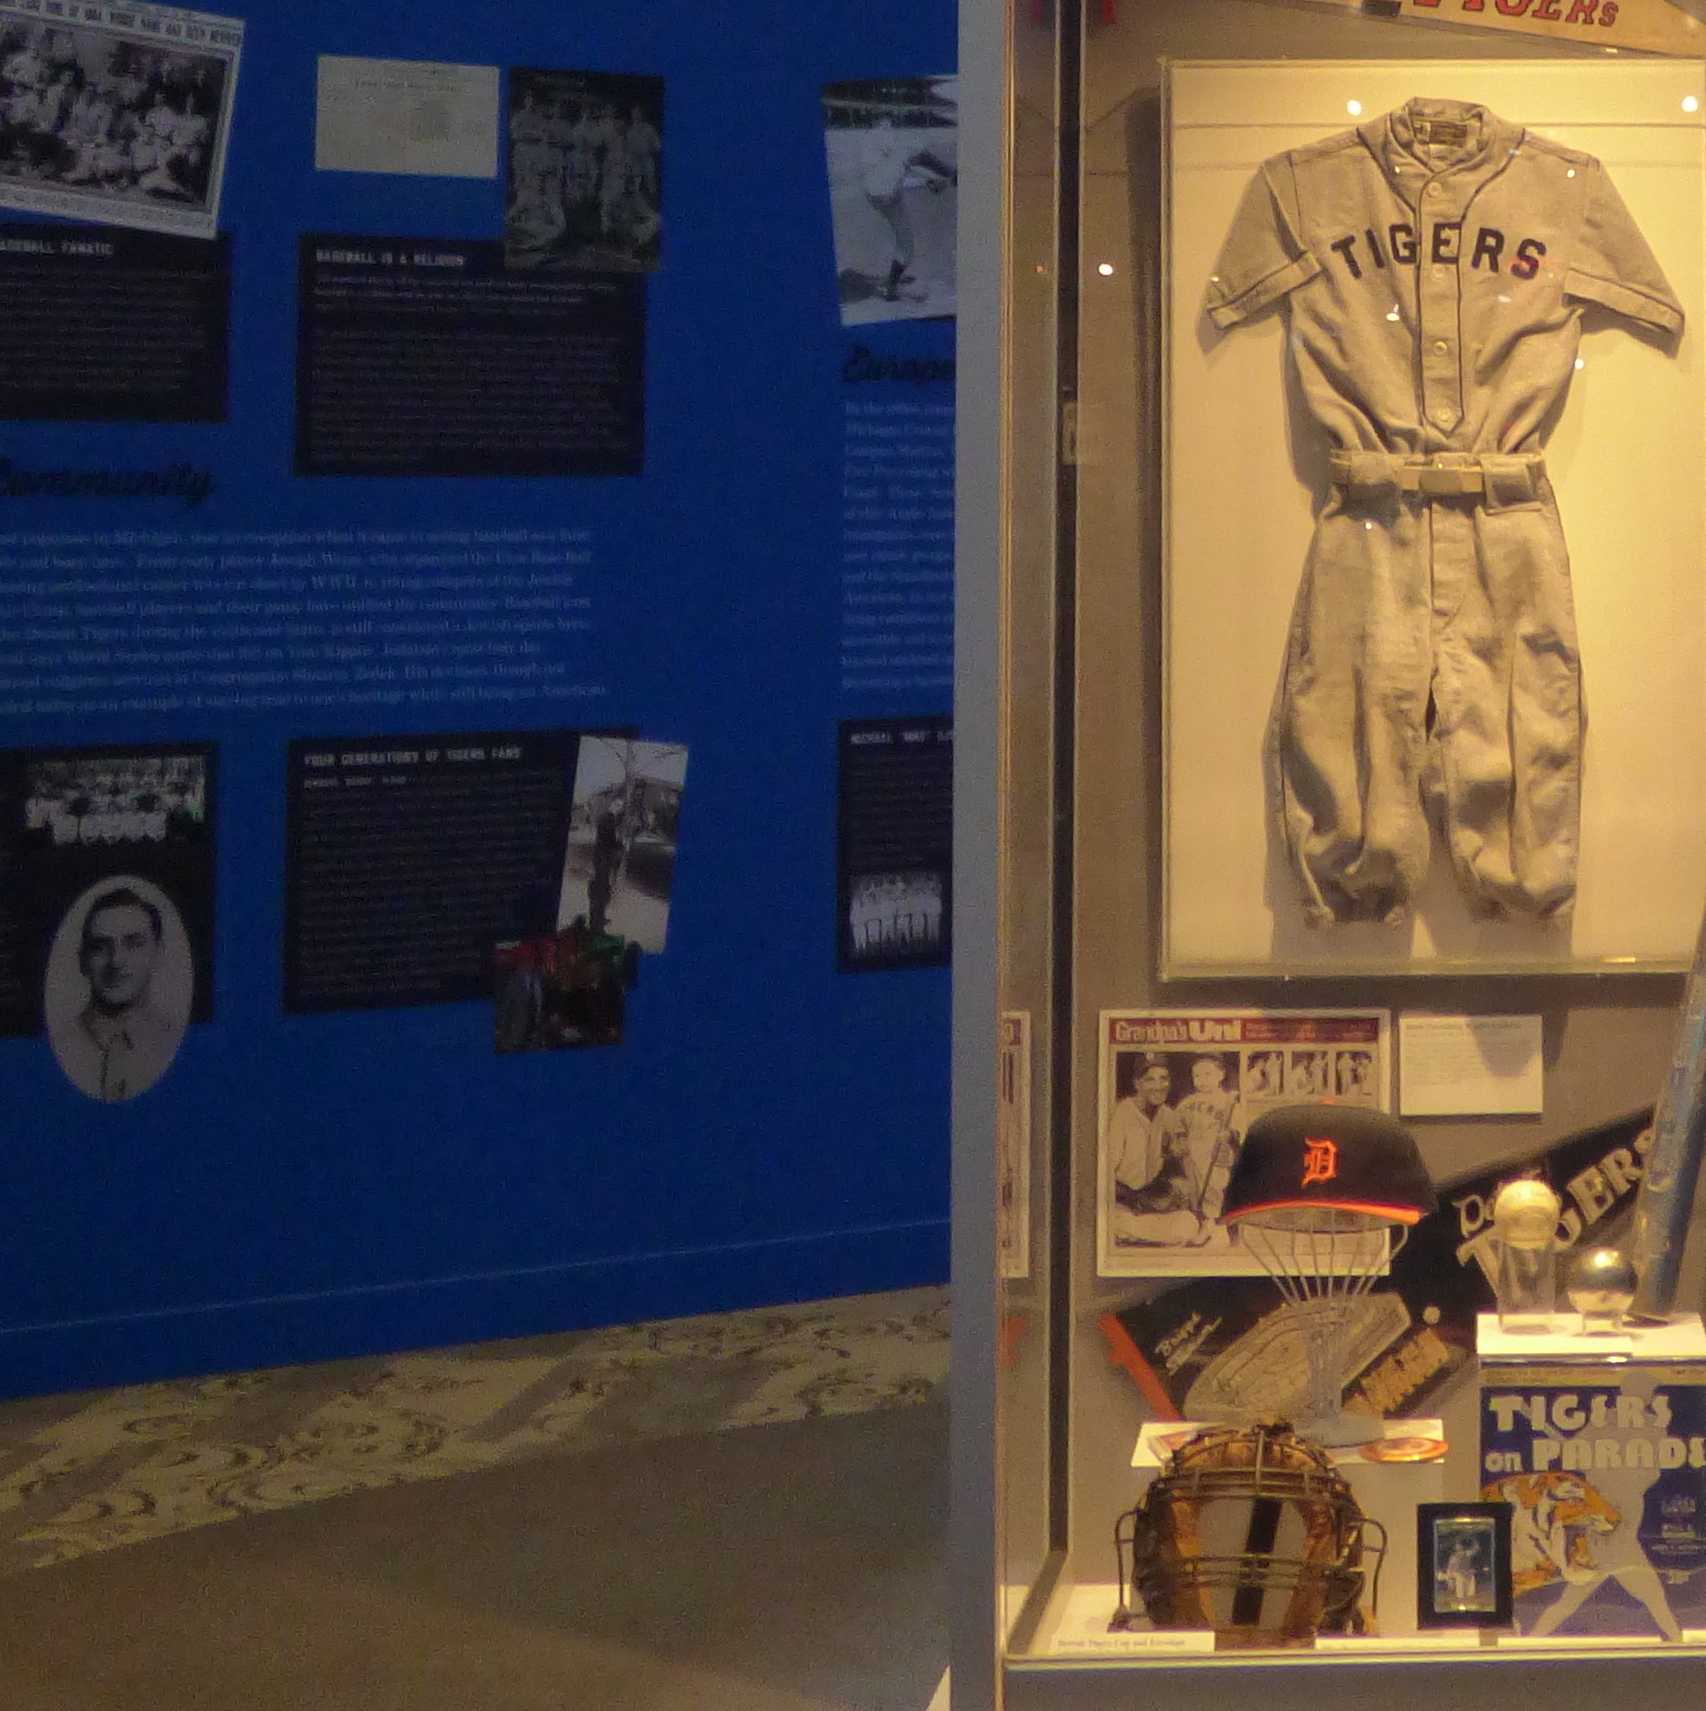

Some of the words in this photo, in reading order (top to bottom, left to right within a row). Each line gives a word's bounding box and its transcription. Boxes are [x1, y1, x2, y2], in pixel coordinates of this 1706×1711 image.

[1331, 220, 1547, 281] TIGERS
[1115, 1019, 1187, 1044] Grandpa's
[1304, 1136, 1338, 1186] D
[1489, 1393, 1673, 1432] TIGERS
[1485, 1450, 1523, 1472] on
